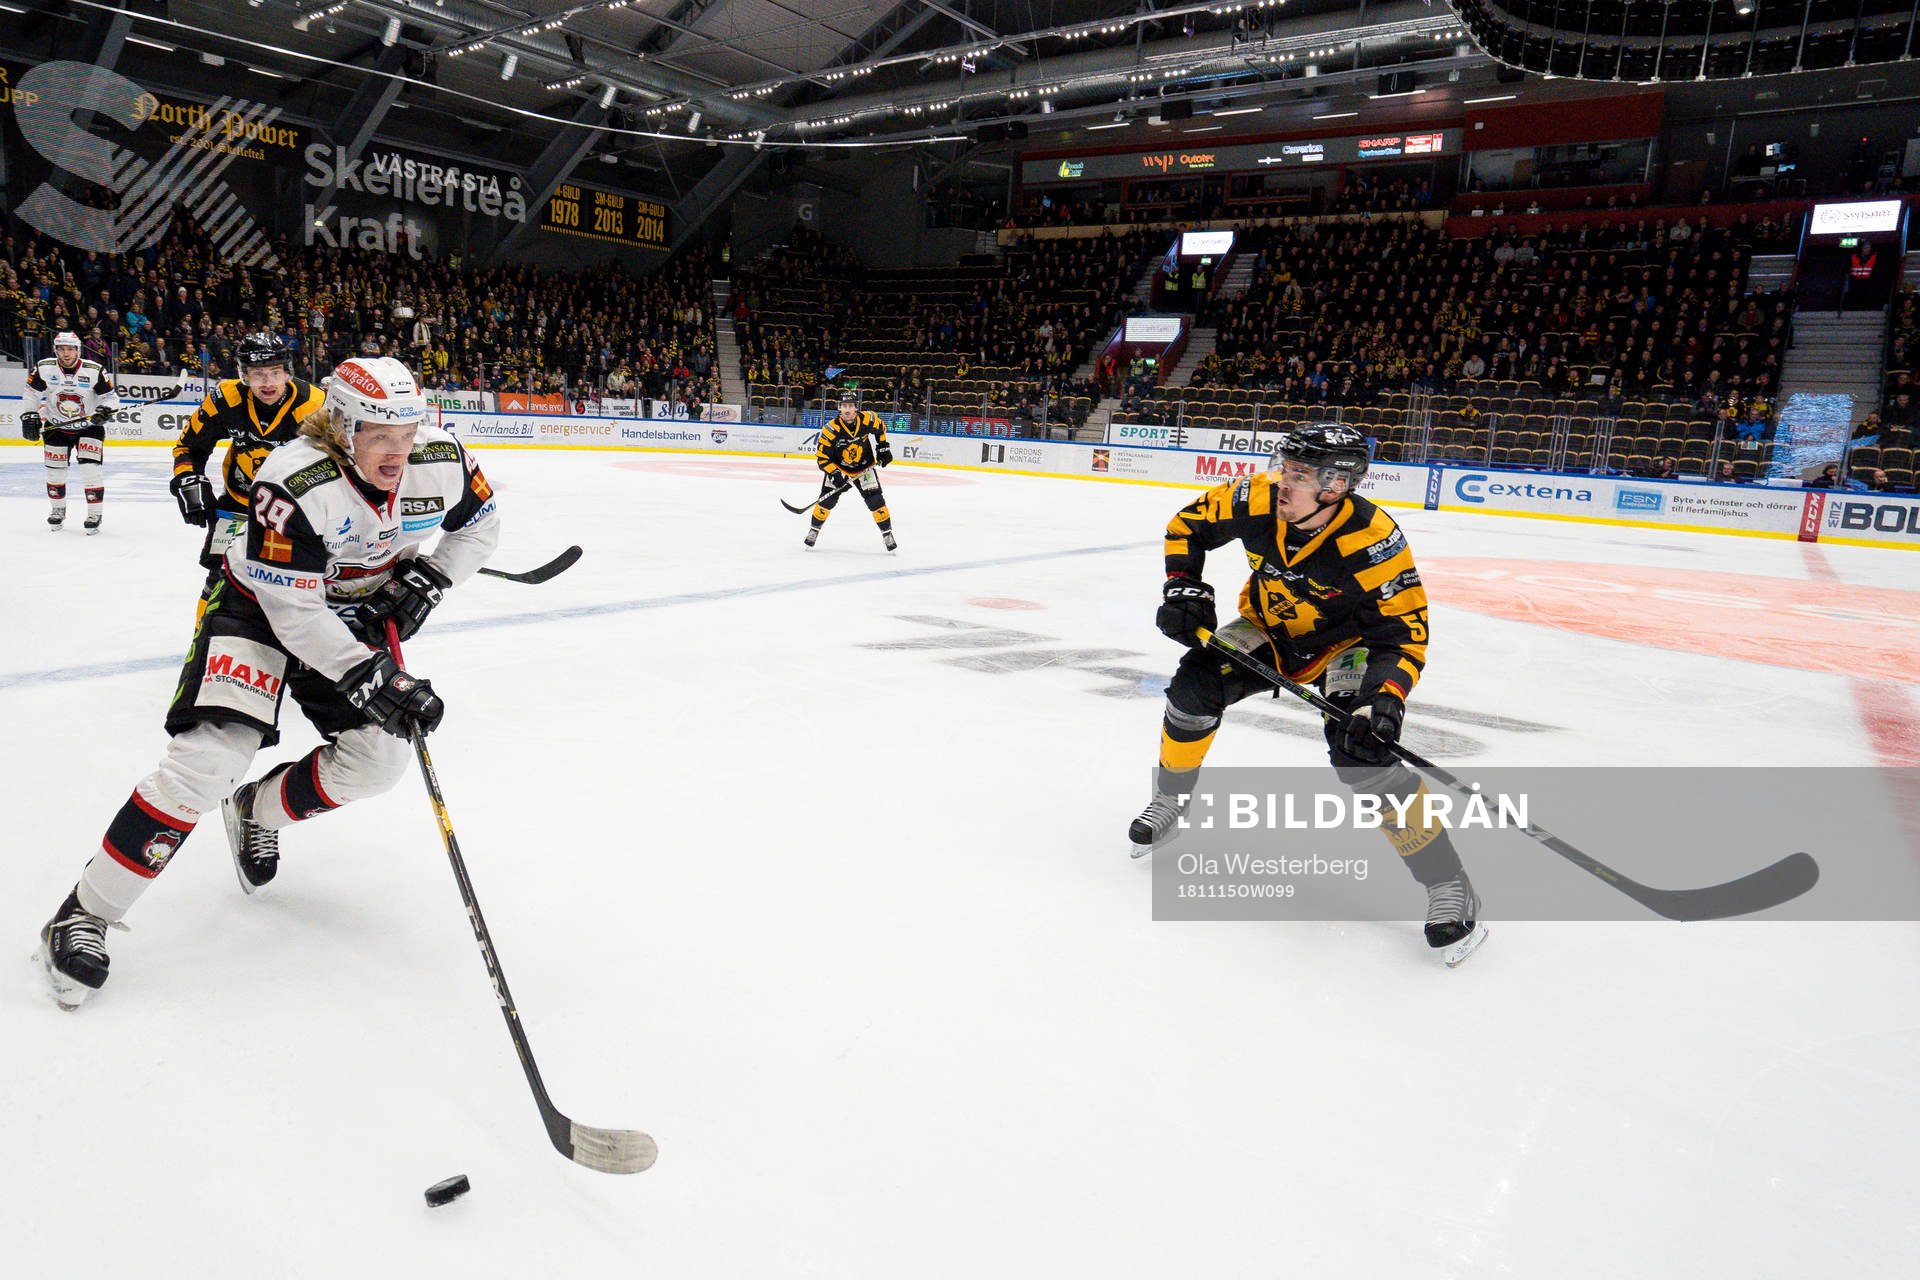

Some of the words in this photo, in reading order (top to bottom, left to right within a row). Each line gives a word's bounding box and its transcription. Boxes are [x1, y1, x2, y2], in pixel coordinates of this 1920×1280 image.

[132, 93, 211, 133] North
[220, 109, 299, 149] Power
[1358, 137, 1401, 149] SHARP
[303, 142, 527, 224] Skellefteå
[373, 152, 459, 189] VÄSTRA
[464, 174, 502, 197] STÅ
[595, 191, 624, 209] SM-GULD
[550, 198, 579, 227] 1978
[638, 201, 665, 218] SM-GULD
[798, 203, 813, 221] G
[594, 207, 623, 235] 2013
[637, 215, 664, 242] 2014
[304, 203, 423, 261] Kraft
[120, 427, 142, 436] Wood
[471, 419, 519, 435] Norrlands
[521, 420, 534, 435] Bil
[540, 422, 611, 438] energiservice
[621, 428, 701, 442] Handelsbanken
[1120, 426, 1168, 439] SPORT
[1010, 447, 1042, 456] FORDONS
[1142, 439, 1166, 447] CITY
[422, 452, 451, 461] HUSET
[904, 446, 919, 459] EY
[1009, 456, 1042, 464] MONTAGE
[1195, 456, 1256, 478] MAXI
[304, 471, 331, 487] HUSET
[1429, 468, 1440, 505] CCM
[1488, 483, 1592, 502] extena
[1622, 494, 1657, 504] FSN
[255, 485, 295, 536] 29
[401, 500, 440, 512] RSA
[1672, 505, 1684, 513] till
[1686, 506, 1749, 518] flerfamiljshus
[1673, 495, 1694, 505] Byte
[1709, 498, 1743, 507] fönster
[1767, 502, 1798, 511] dörrar
[1805, 492, 1821, 533] CCM
[207, 654, 281, 695] MAXI
[215, 675, 276, 702] STORMARKNAD
